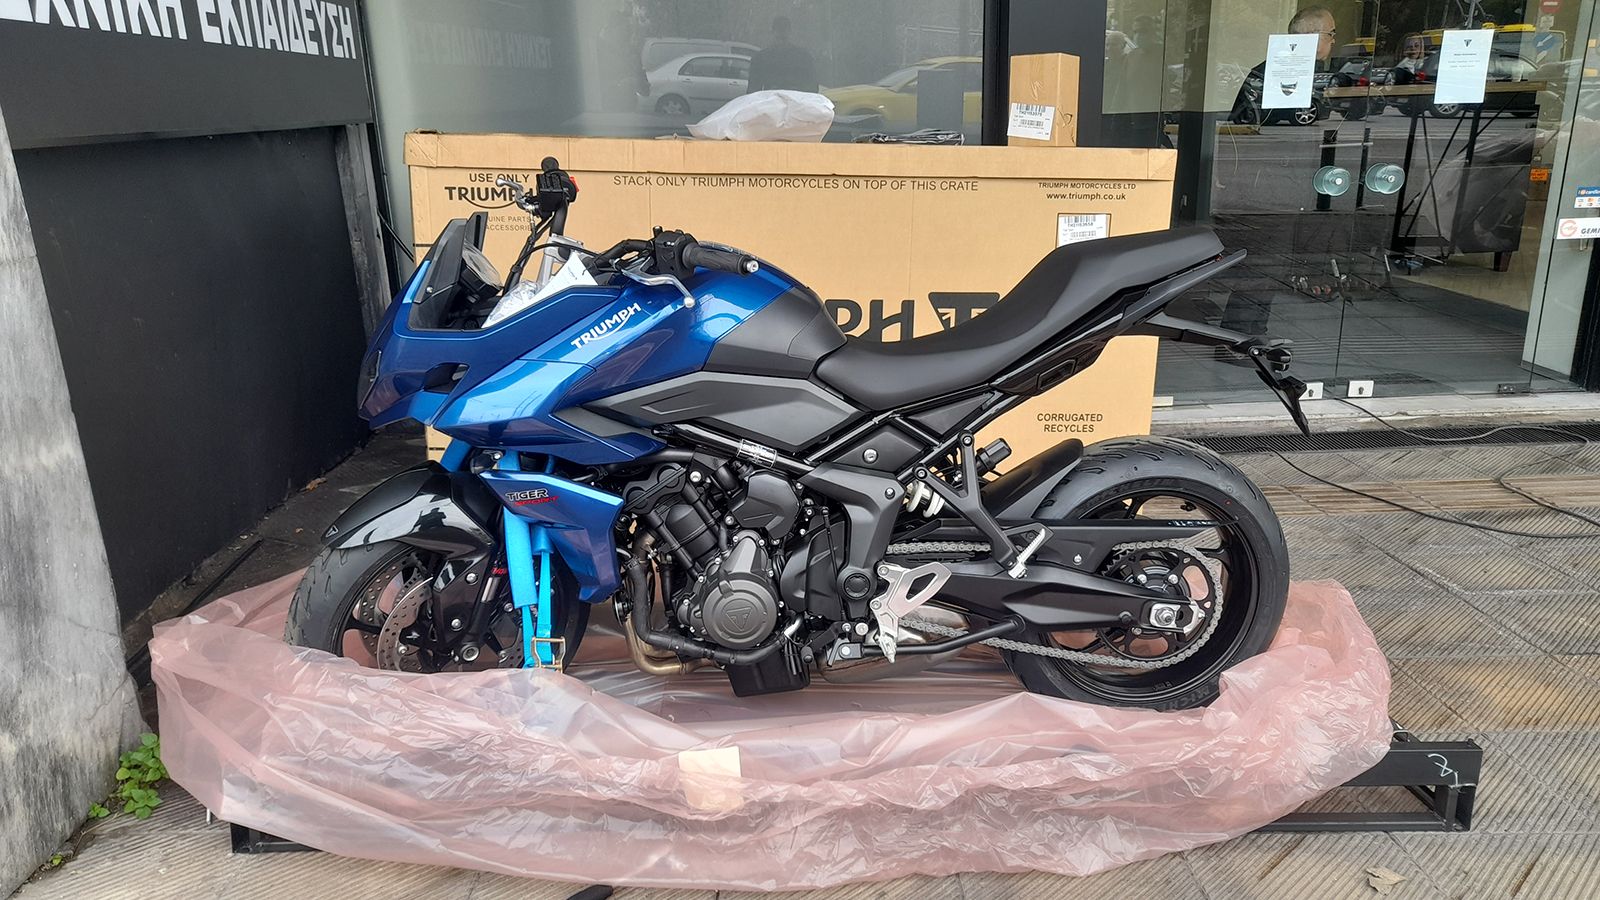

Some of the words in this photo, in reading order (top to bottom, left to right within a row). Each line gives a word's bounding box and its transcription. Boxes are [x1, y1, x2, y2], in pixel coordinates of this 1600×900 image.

[469, 173, 493, 183] USE
[497, 173, 530, 183] ONLY
[613, 175, 652, 186] STACK
[655, 176, 688, 187] ONLY
[691, 176, 745, 188] TRIUMPH
[748, 178, 839, 189] MOTORCYCLES
[842, 179, 860, 189] ON
[864, 179, 888, 190] TOP
[890, 180, 906, 190] OF
[911, 181, 937, 191] THIS
[939, 181, 978, 191] CRATE
[1070, 182, 1122, 190] MOTORCYCLES
[444, 186, 533, 209] TRIUMP
[1046, 192, 1127, 201] www.triumph.co.uk
[570, 302, 642, 349] TRIUMPH
[1036, 413, 1103, 422] CORRUGATED
[1043, 424, 1095, 433] RECYCLES
[505, 487, 549, 502] TIGER
